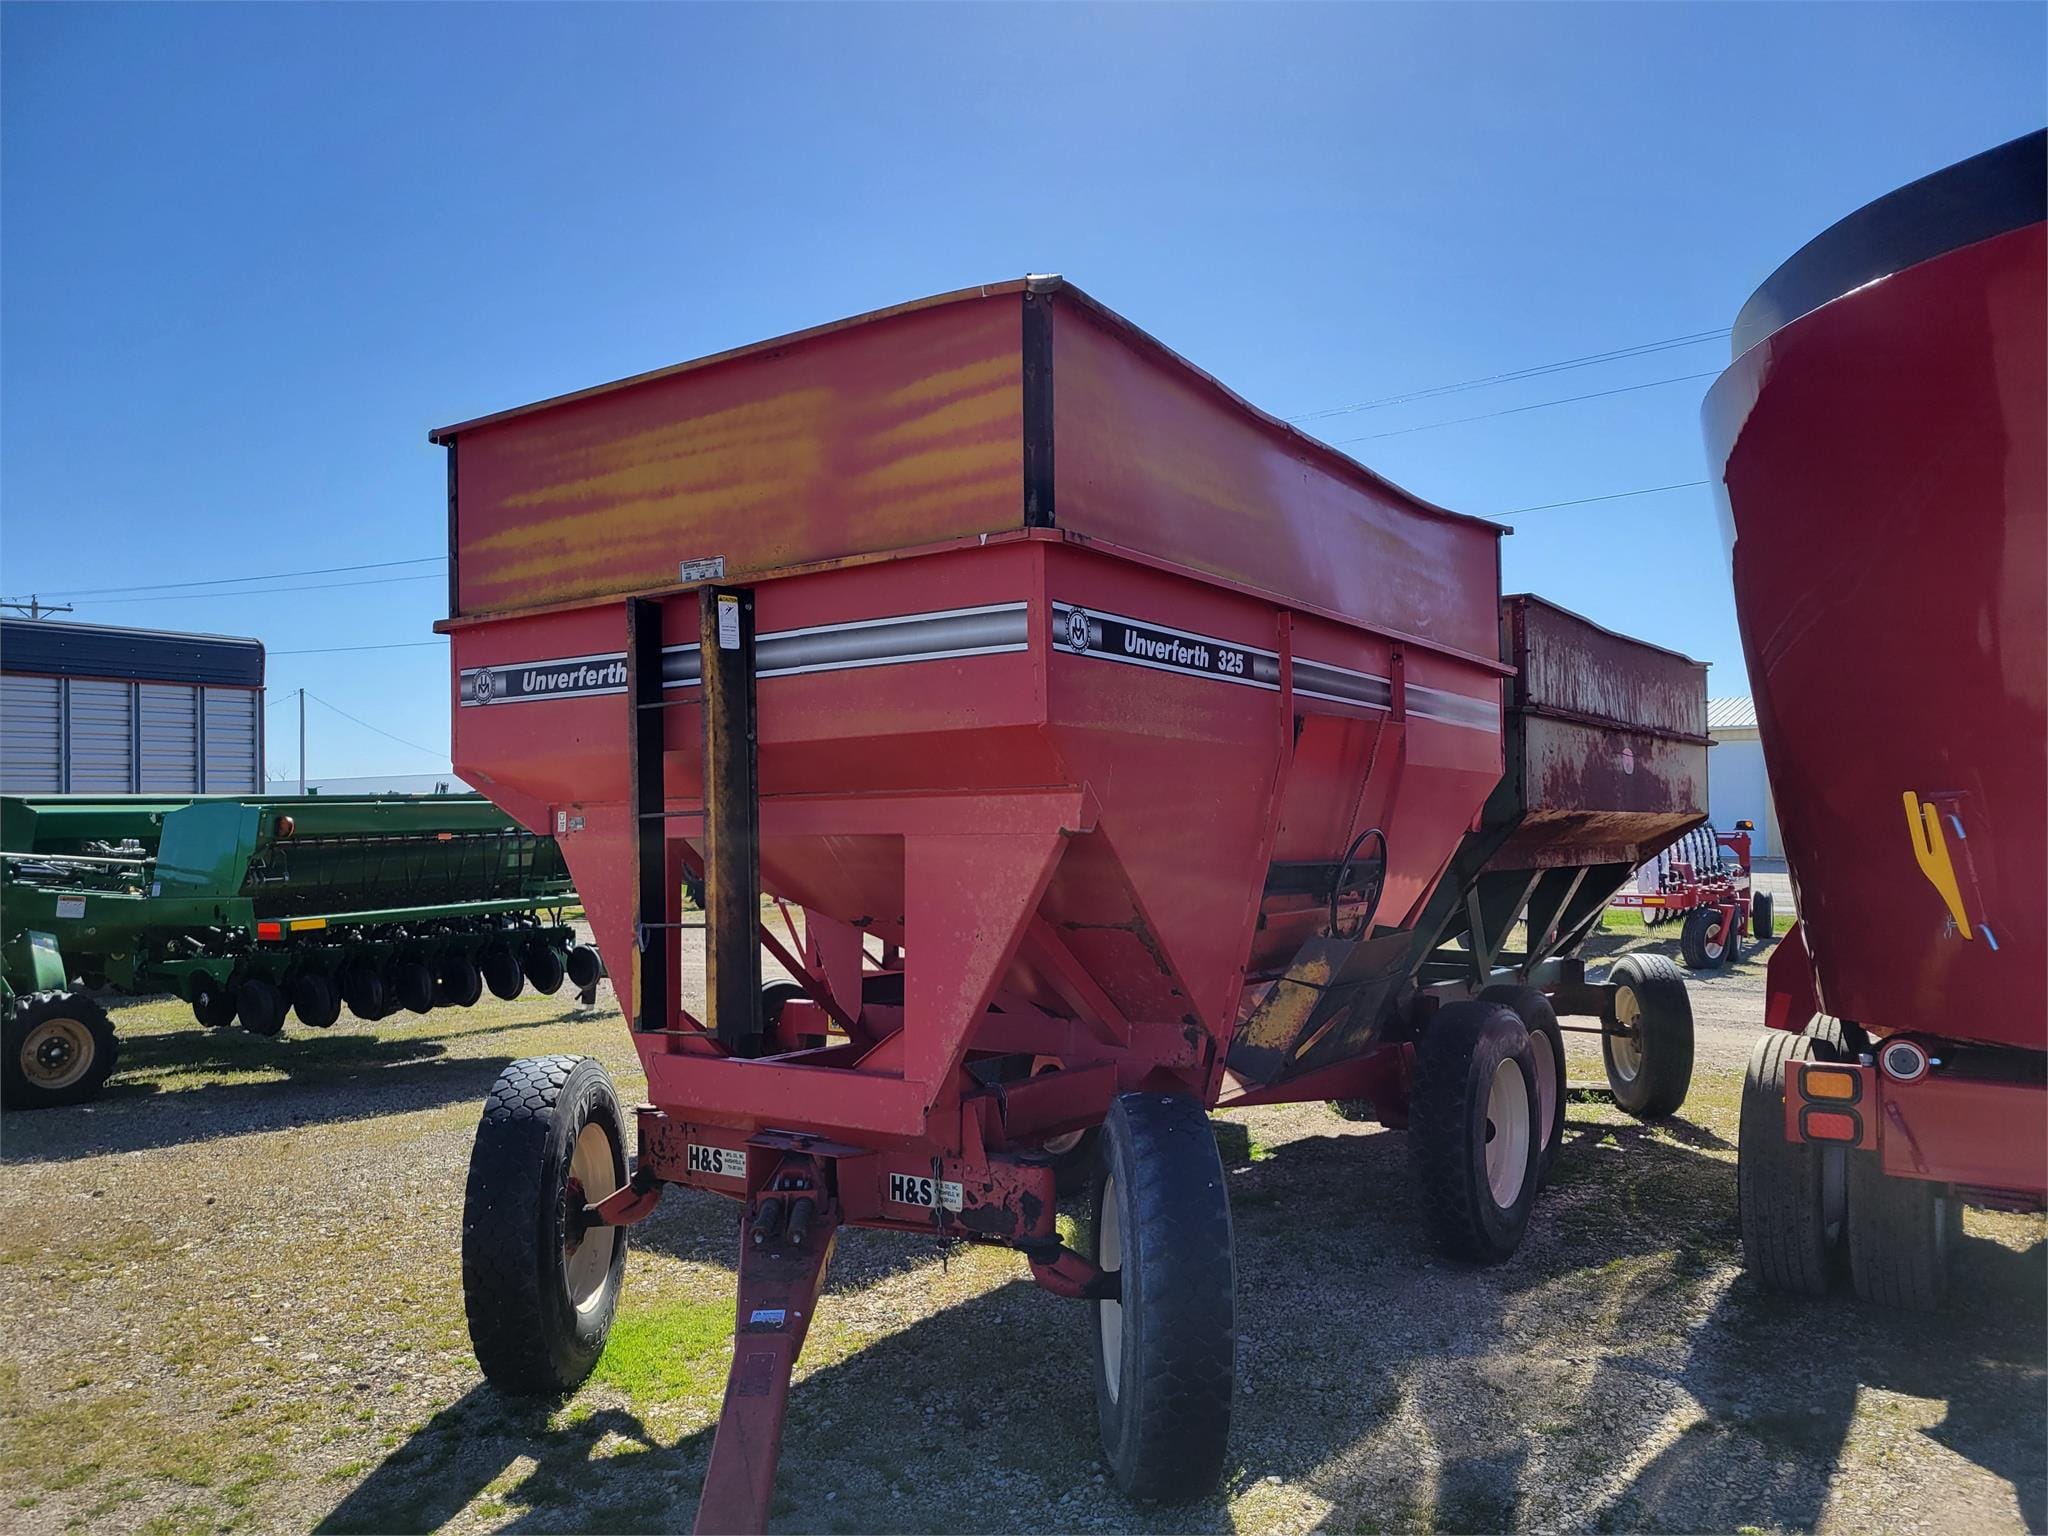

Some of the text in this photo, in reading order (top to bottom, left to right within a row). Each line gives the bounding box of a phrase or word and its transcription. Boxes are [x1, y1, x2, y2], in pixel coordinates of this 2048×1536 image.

[1124, 629, 1244, 674] Unverferth 325
[522, 662, 628, 692] Unverferth
[689, 1145, 723, 1173] H&S
[891, 1175, 932, 1206] H&S
